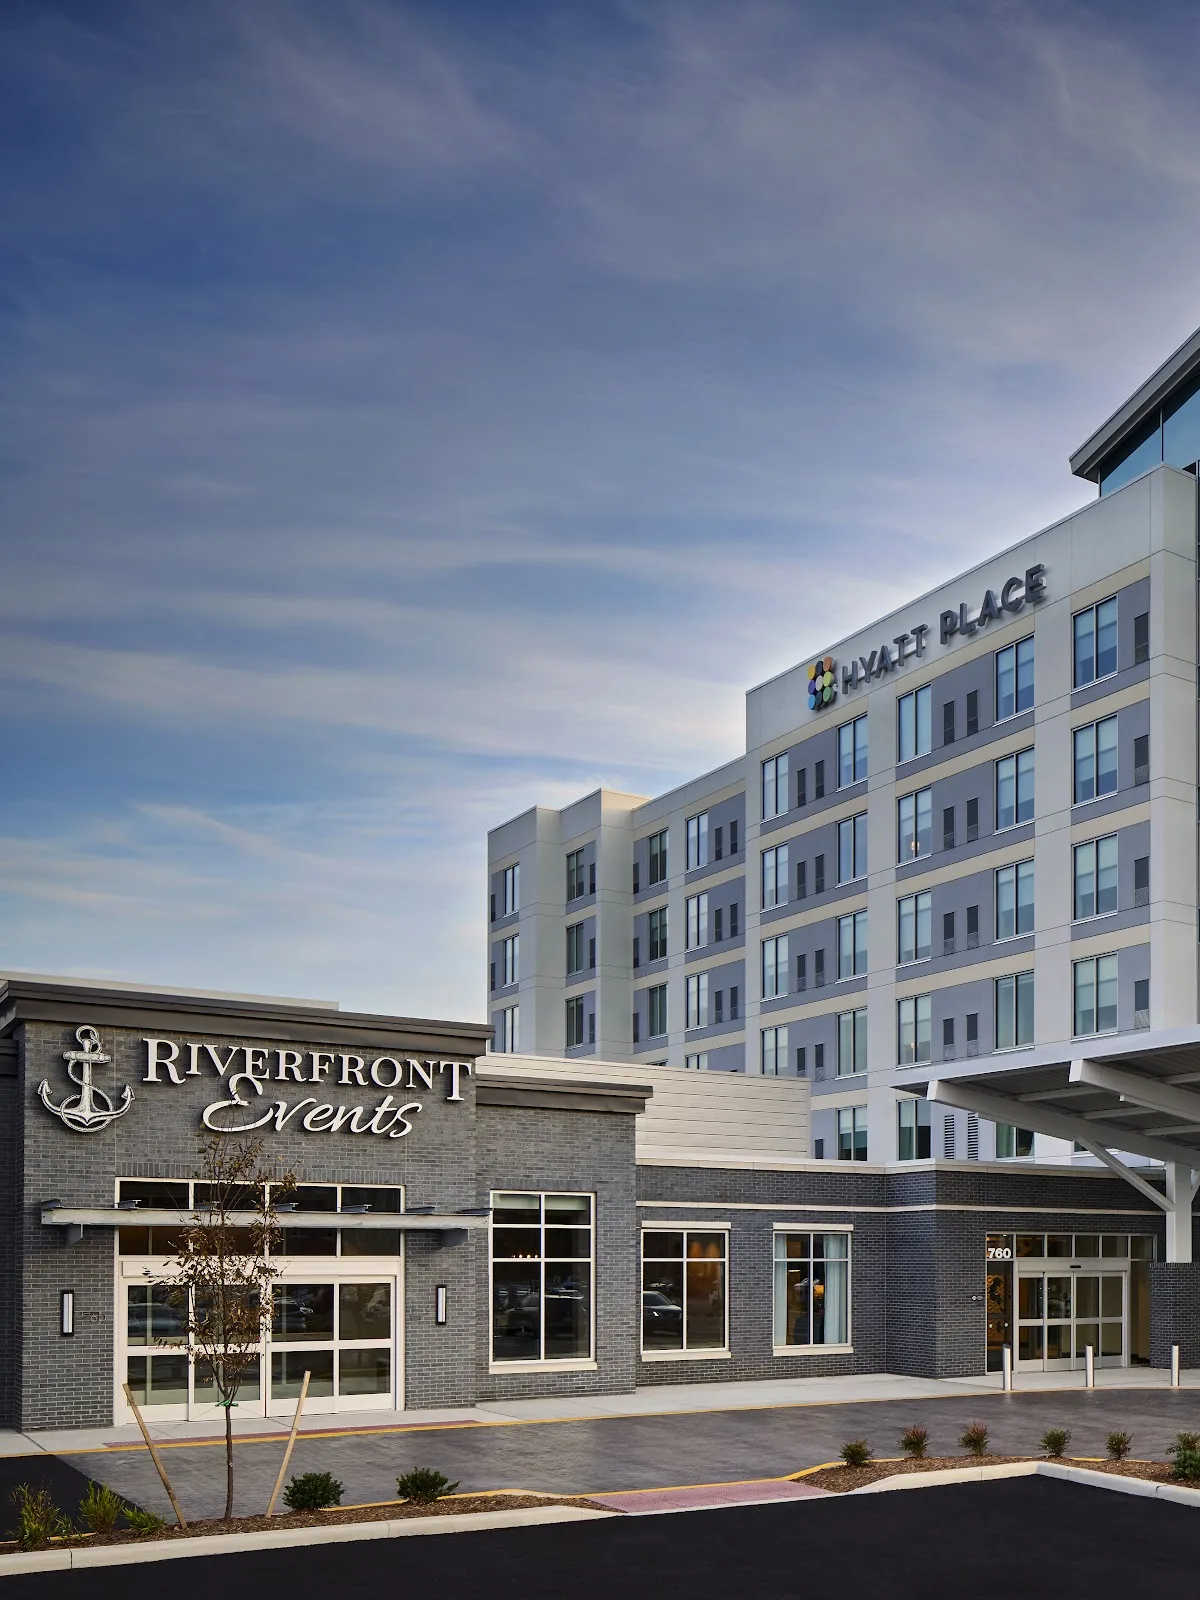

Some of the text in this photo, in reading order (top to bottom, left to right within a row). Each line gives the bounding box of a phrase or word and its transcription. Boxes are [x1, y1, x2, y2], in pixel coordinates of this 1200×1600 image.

[841, 563, 1046, 694] HYATT PLACE
[142, 1038, 472, 1101] RIVERFRONT
[202, 1073, 423, 1138] Events
[988, 1247, 1011, 1259] 760
